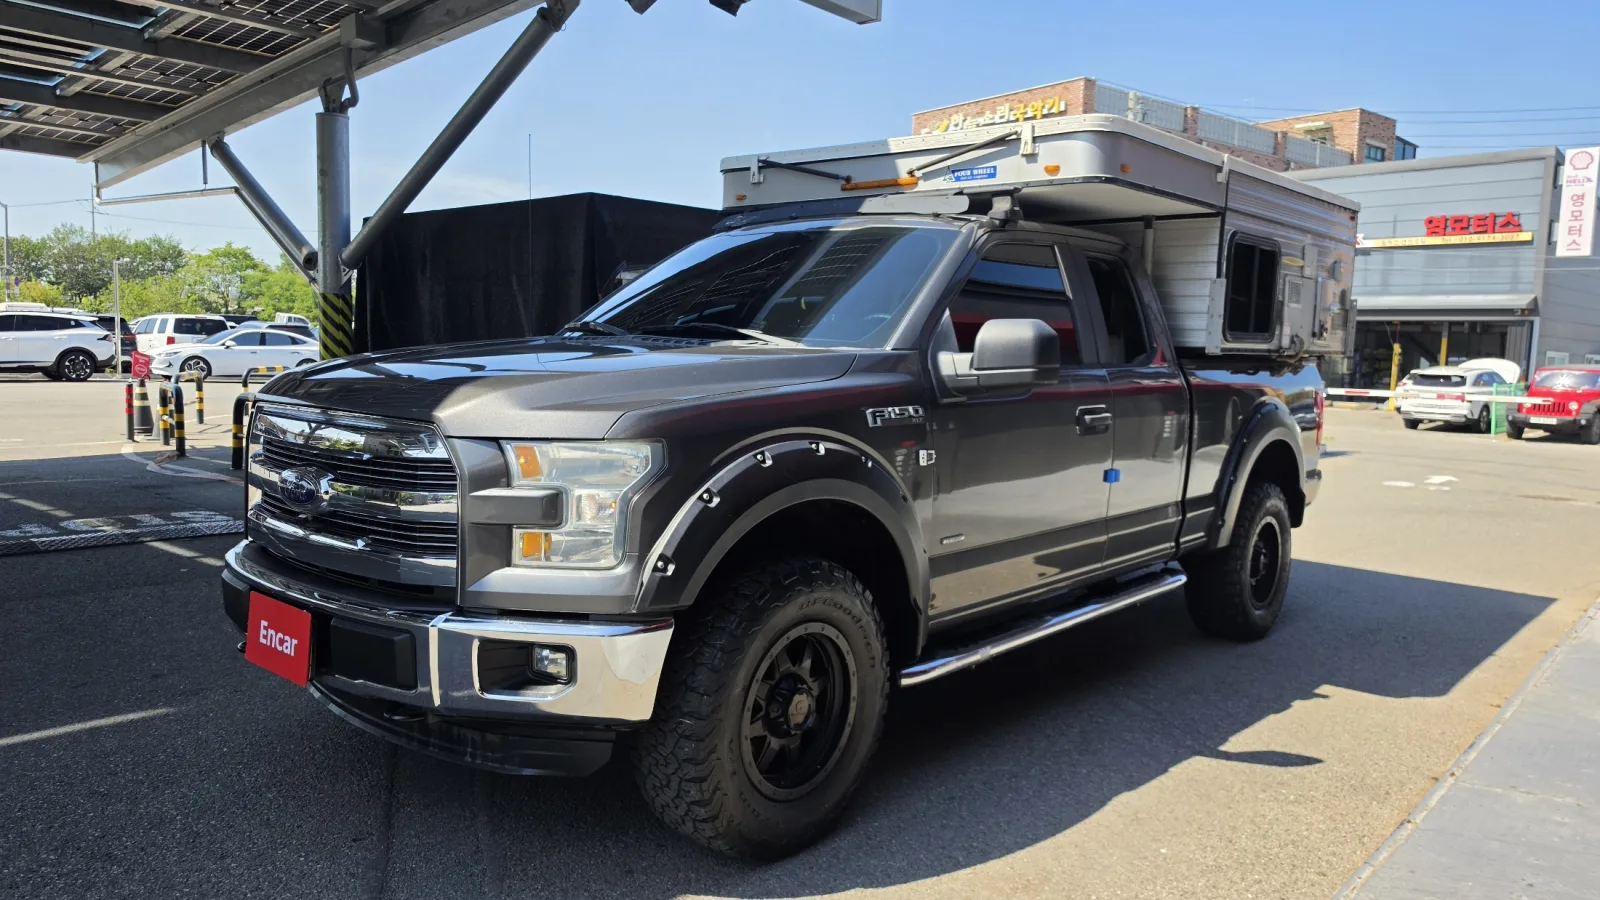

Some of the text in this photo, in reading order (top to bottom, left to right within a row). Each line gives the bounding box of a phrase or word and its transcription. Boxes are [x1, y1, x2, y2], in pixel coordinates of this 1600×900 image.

[972, 167, 995, 175] WHEEL
[1565, 192, 1585, 251] 영모터스
[259, 619, 298, 657] Encar
[798, 597, 876, 668] BFGoodrich
